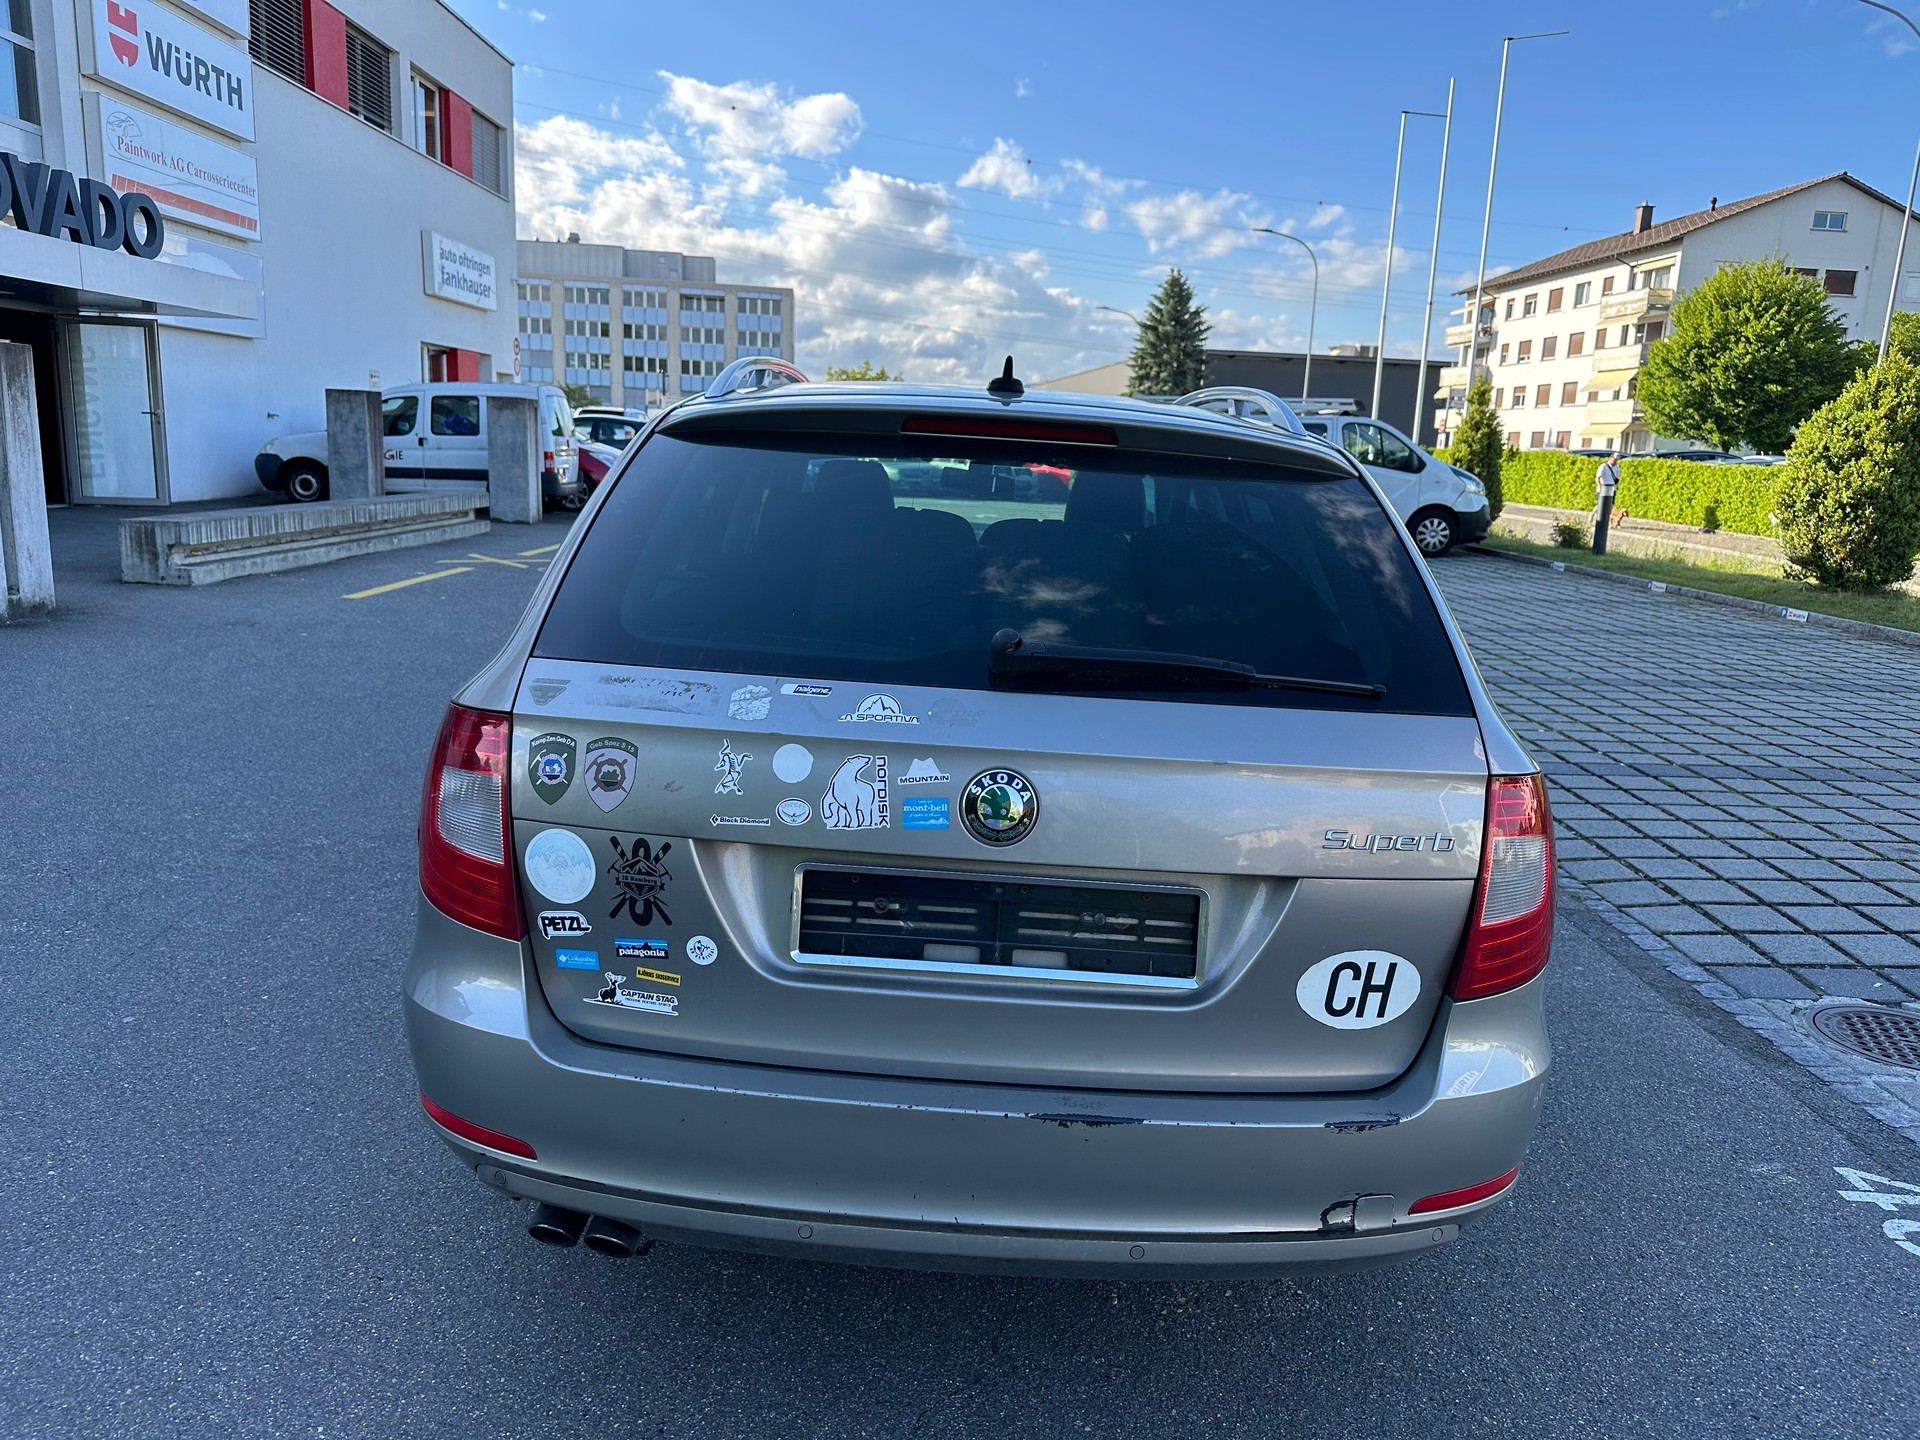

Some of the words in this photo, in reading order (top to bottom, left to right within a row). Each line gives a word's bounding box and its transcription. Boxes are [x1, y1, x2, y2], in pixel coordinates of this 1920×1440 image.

[145, 30, 243, 111] WÜRTH
[117, 135, 168, 167] Paintwork
[169, 156, 185, 173] AG
[186, 161, 257, 198] Carrosseriecenter
[440, 246, 458, 265] auto
[458, 252, 491, 277] oftringen
[441, 265, 491, 299] fankhauser
[796, 685, 831, 694] nalgene
[590, 741, 603, 749] Geb
[627, 745, 635, 753] 15
[900, 775, 949, 784] MOUNTAIN
[1322, 829, 1456, 854] Superb
[540, 916, 591, 938] PETZL
[566, 954, 596, 963] Columbia
[618, 948, 665, 958] patagonia
[621, 989, 654, 1000] CAPTAIN
[655, 995, 675, 1004] STAG
[1324, 961, 1398, 1018] CH
